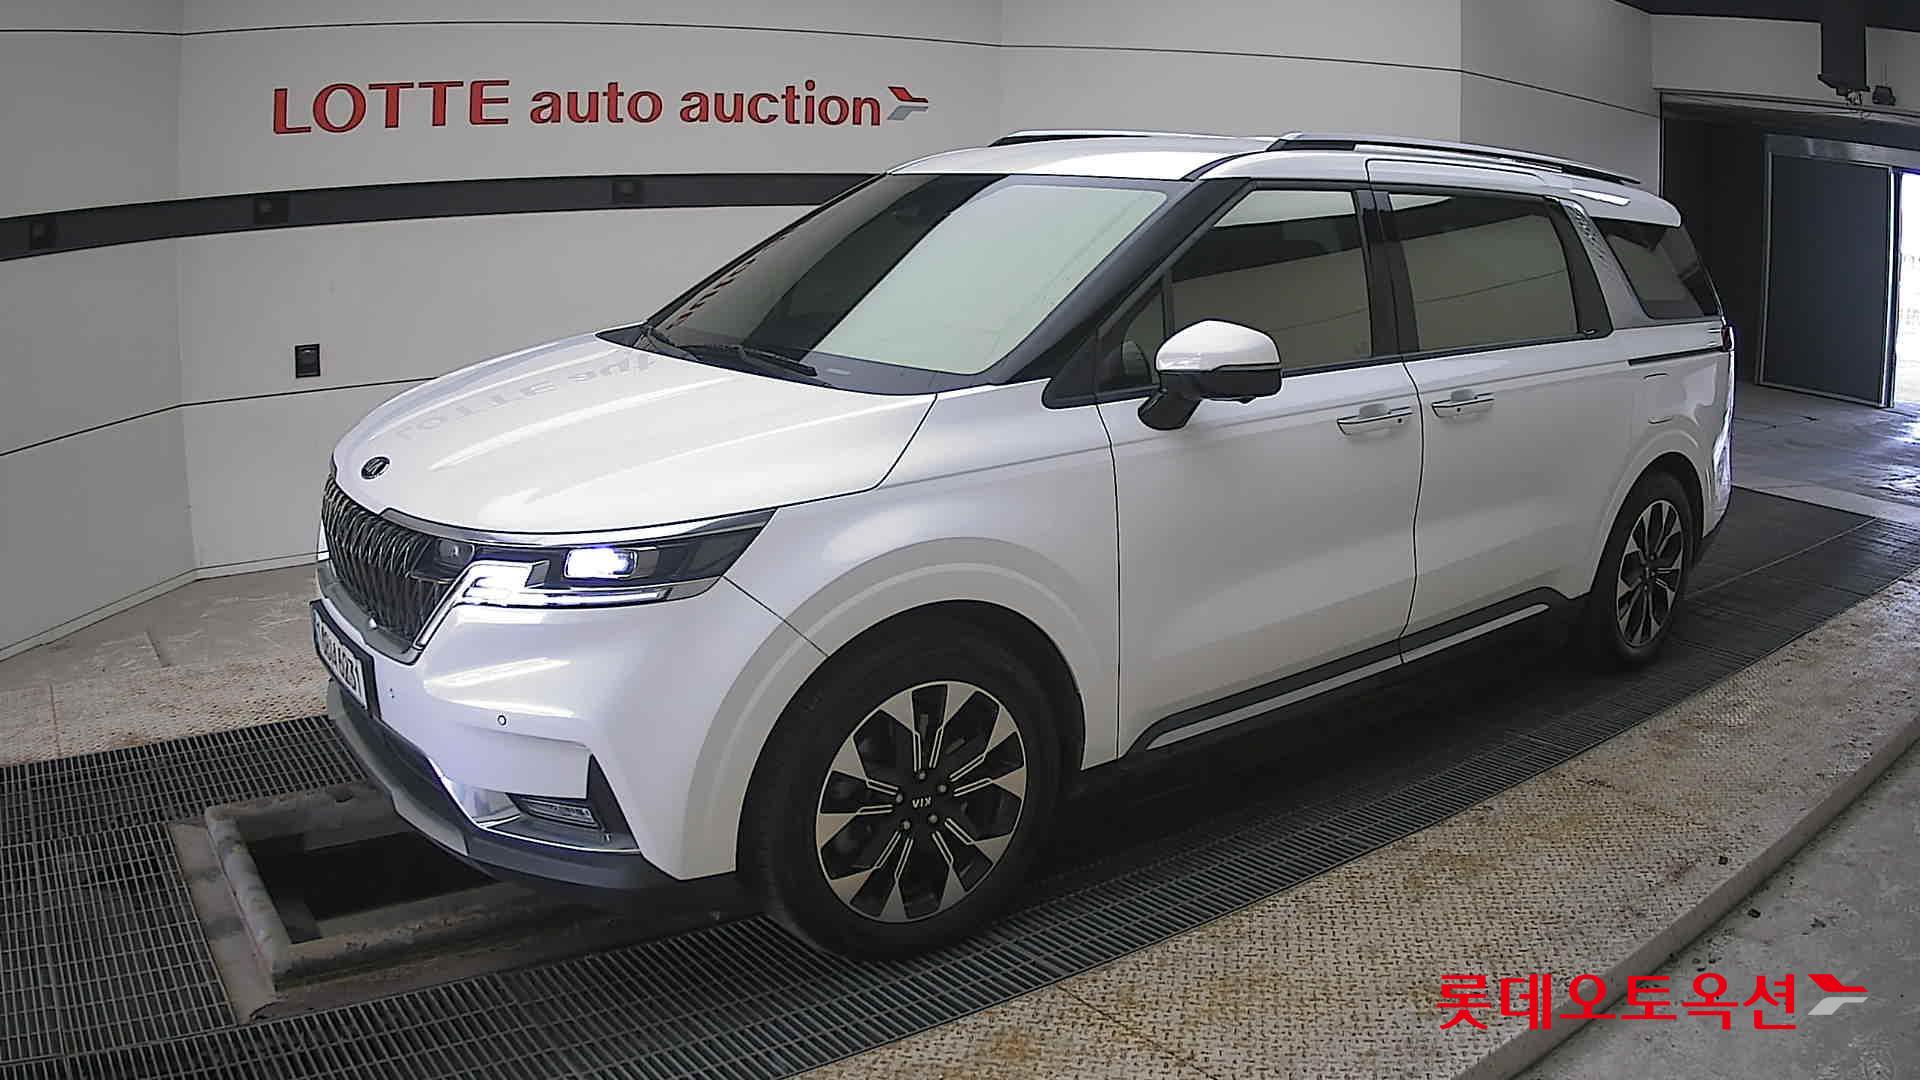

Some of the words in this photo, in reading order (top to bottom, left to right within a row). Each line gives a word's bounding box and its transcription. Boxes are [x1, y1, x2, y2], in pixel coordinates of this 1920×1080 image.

[273, 80, 509, 134] LOTTE
[529, 83, 664, 125] auto
[679, 79, 882, 127] auction
